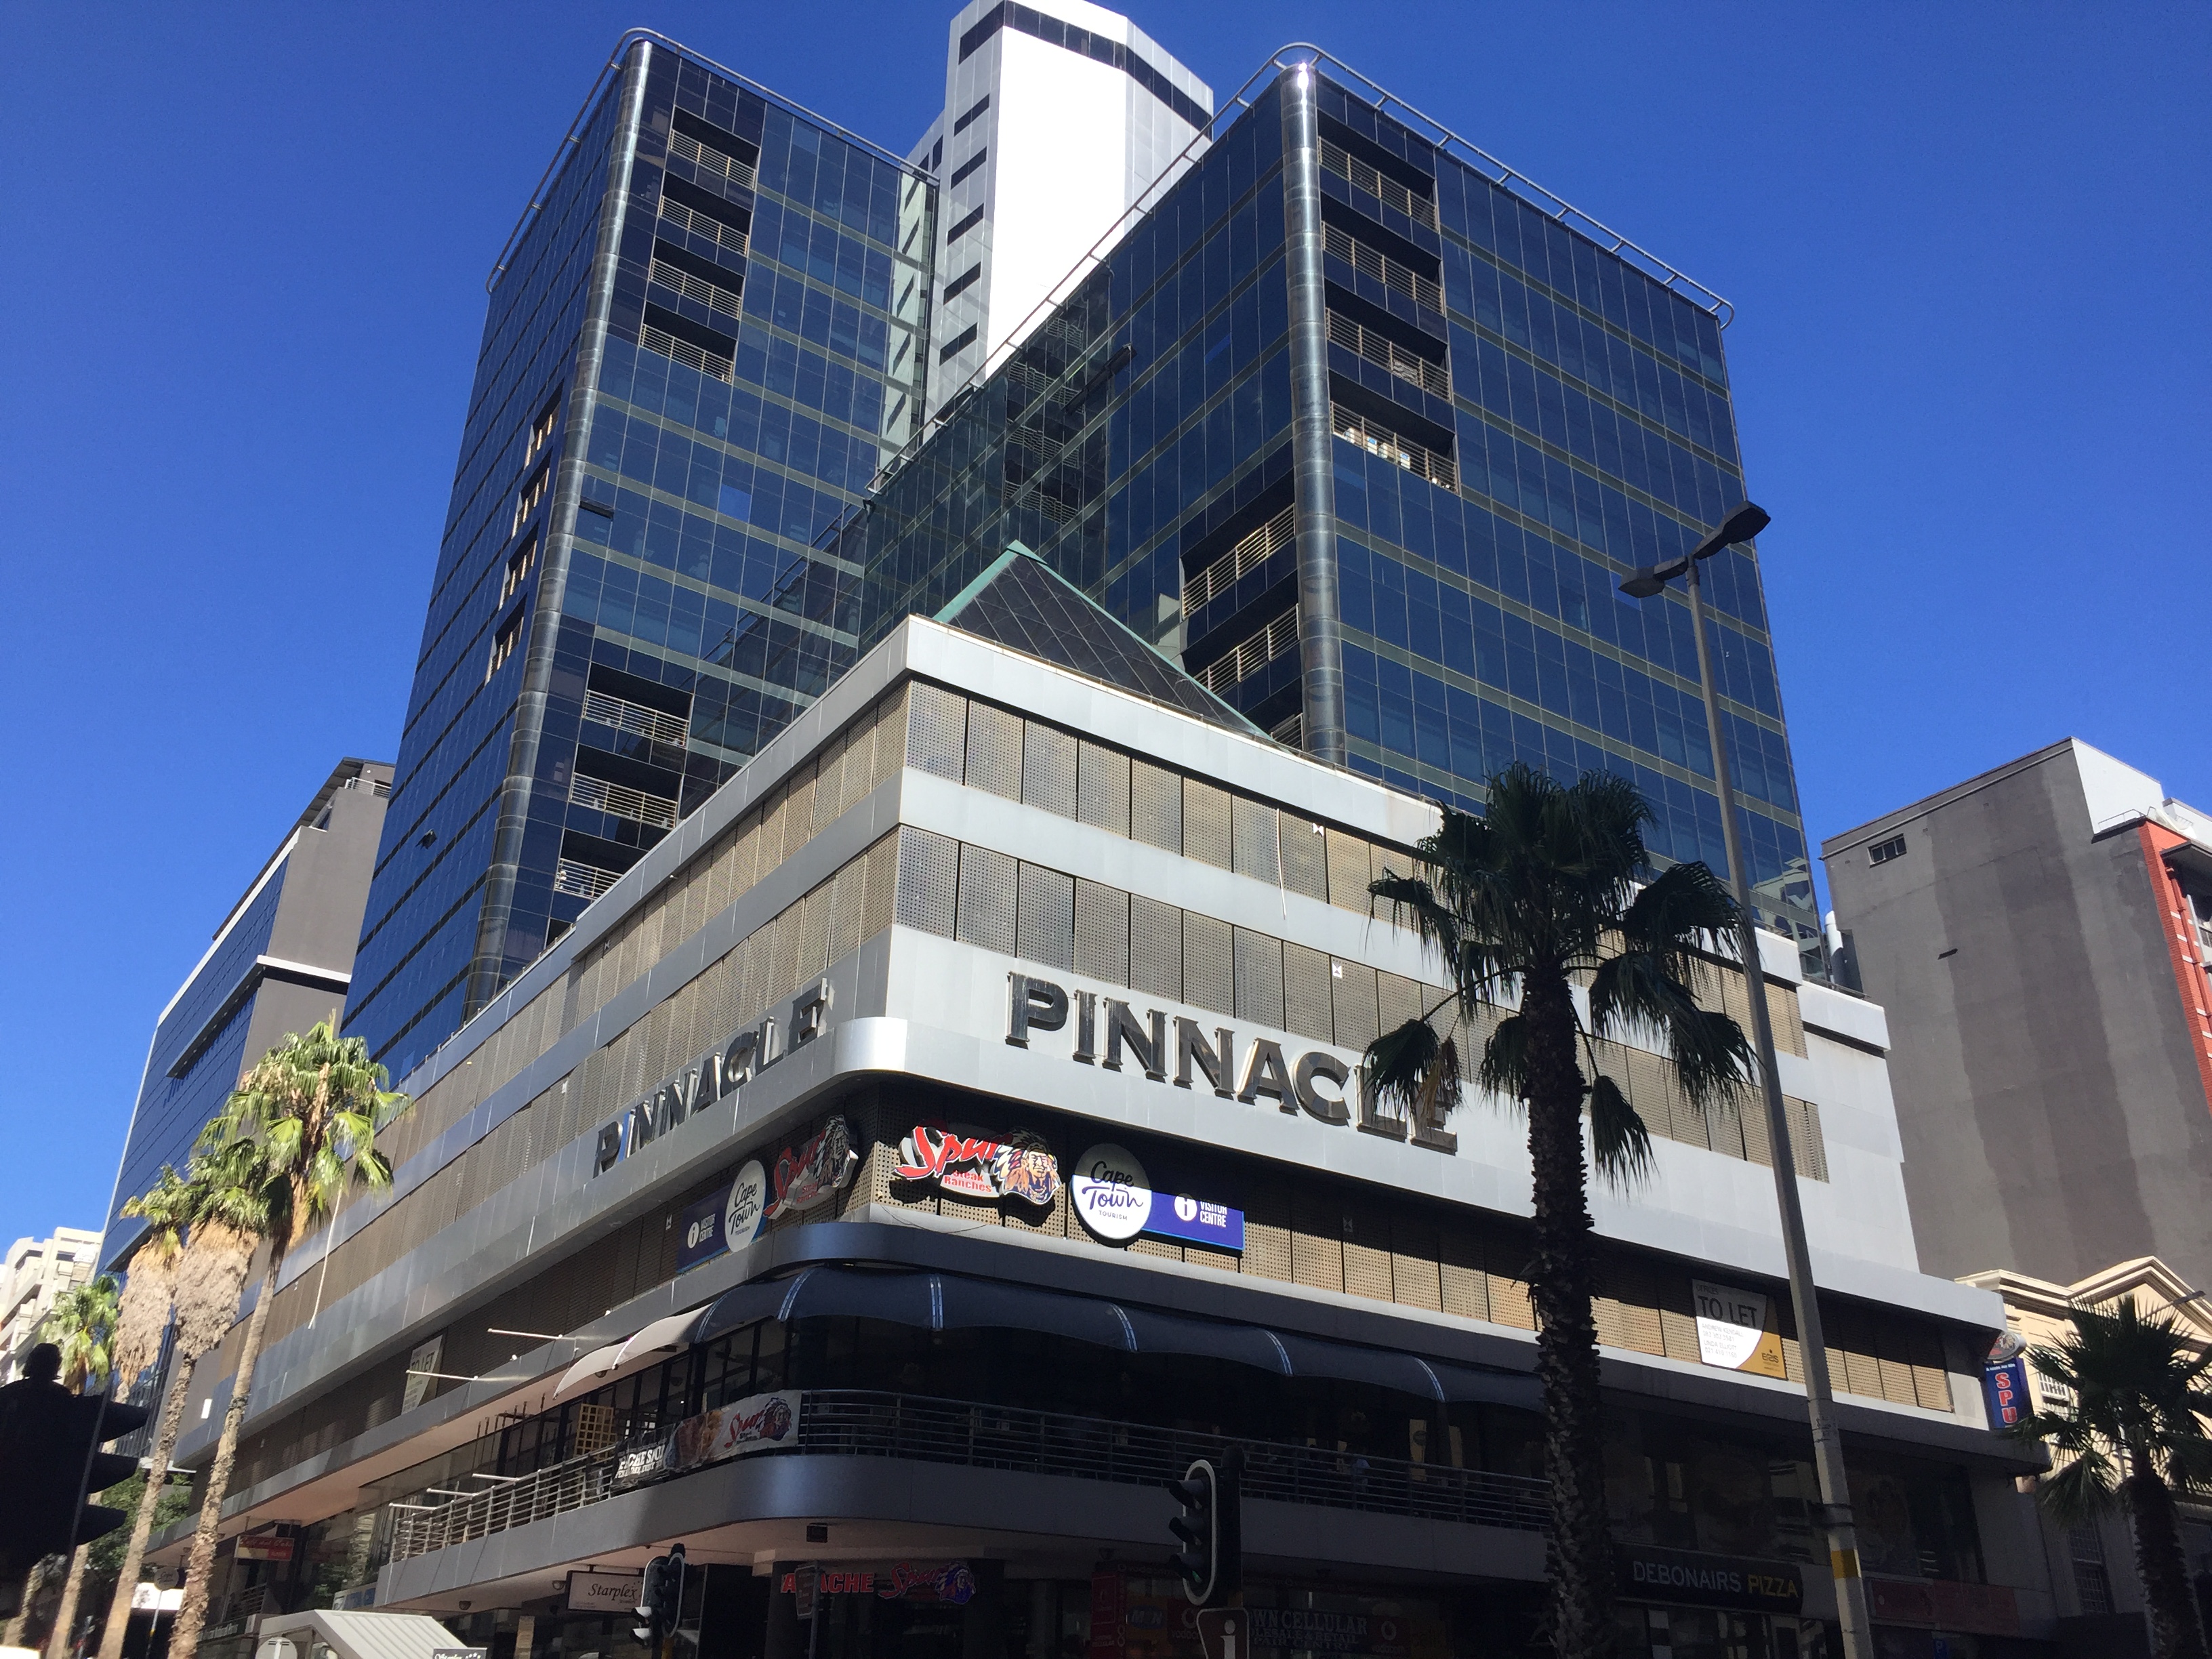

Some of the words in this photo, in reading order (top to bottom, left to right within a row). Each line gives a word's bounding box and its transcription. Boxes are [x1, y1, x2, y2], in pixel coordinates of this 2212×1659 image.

[1005, 971, 1458, 1155] PINNACLE
[593, 977, 827, 1179] PINNACLE
[891, 1118, 1013, 1180] Spur
[945, 1176, 992, 1193] Ranches
[954, 1170, 983, 1182] Steak
[1090, 1161, 1134, 1191] Cape
[735, 1182, 757, 1208] Cape
[1082, 1186, 1143, 1210] Town
[1200, 1199, 1227, 1214] VISITOR
[729, 1201, 760, 1235] Town
[1099, 1210, 1128, 1221] TOURISM
[1200, 1210, 1227, 1227] CENTRE
[1698, 1295, 1723, 1319] TO
[1728, 1302, 1757, 1328] LET
[1633, 1560, 1742, 1593] DEBONAIRS
[1747, 1574, 1799, 1598] PIZZA
[588, 1583, 638, 1601] Starplex
[1282, 1610, 1368, 1635] CELLULAR
[1316, 1632, 1359, 1644] RETAIL
